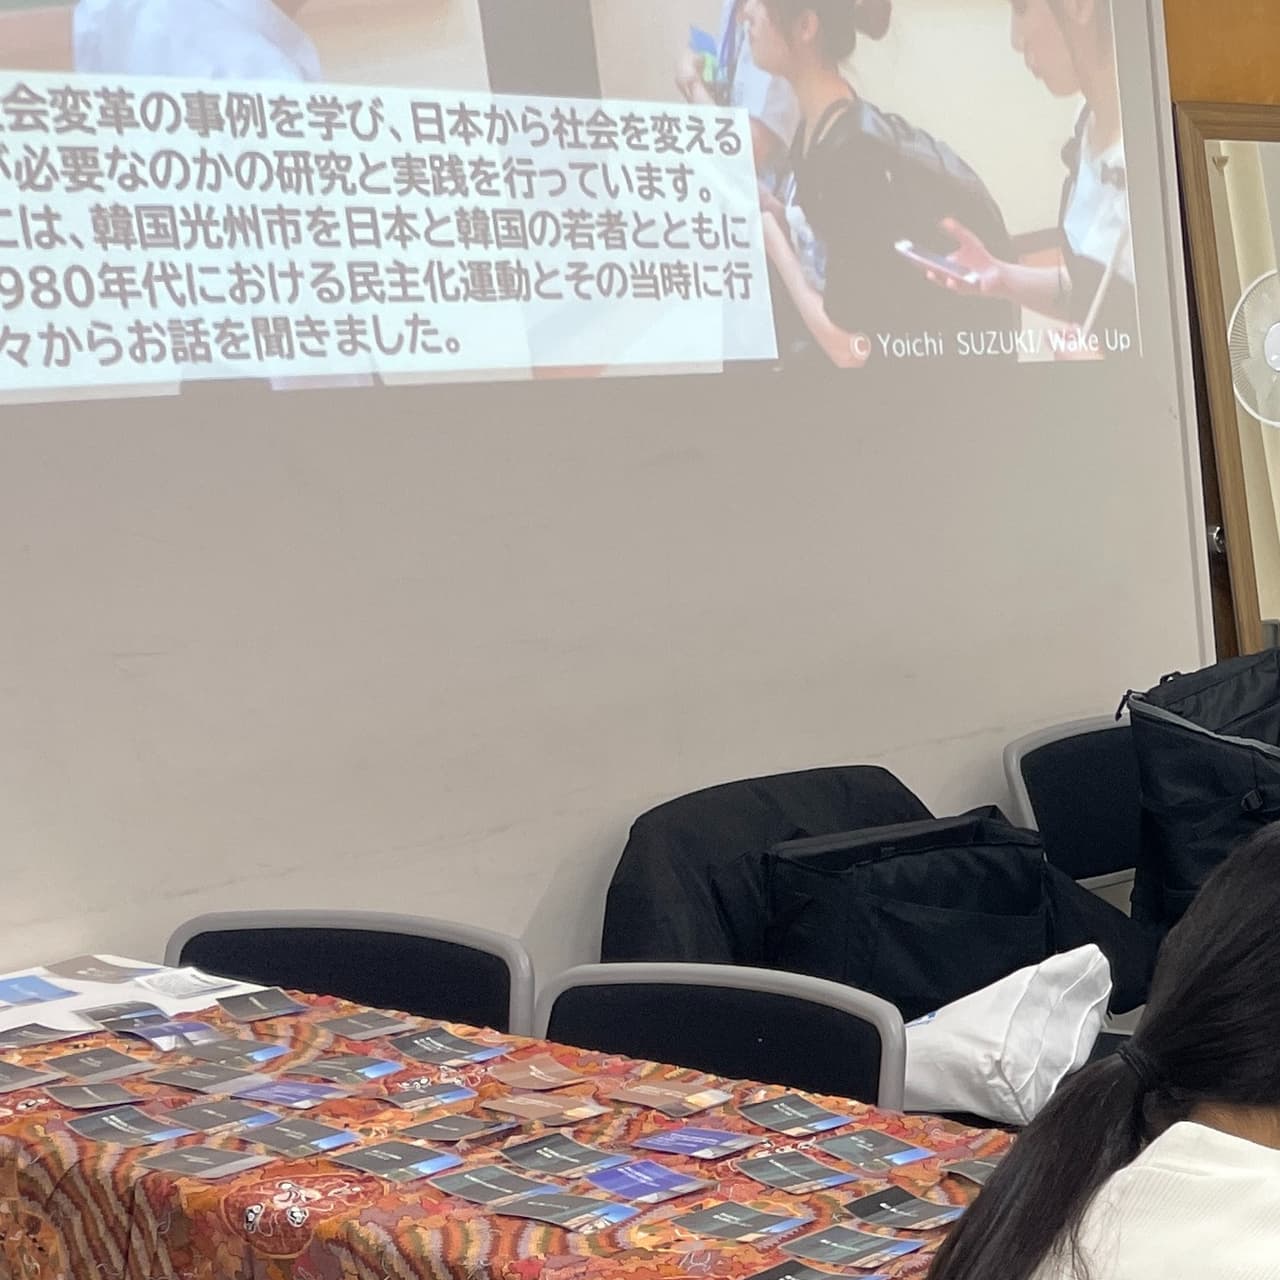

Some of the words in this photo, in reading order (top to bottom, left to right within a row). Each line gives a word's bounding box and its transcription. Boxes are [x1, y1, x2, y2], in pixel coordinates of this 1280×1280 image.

[0, 83, 742, 156] 会変革の事例を学び、日本から社会を変える
[0, 313, 461, 368] 々からお話を聞きました。
[877, 332, 944, 358] Yoichi
[1048, 328, 1099, 353] Wake
[1105, 328, 1131, 353] Up
